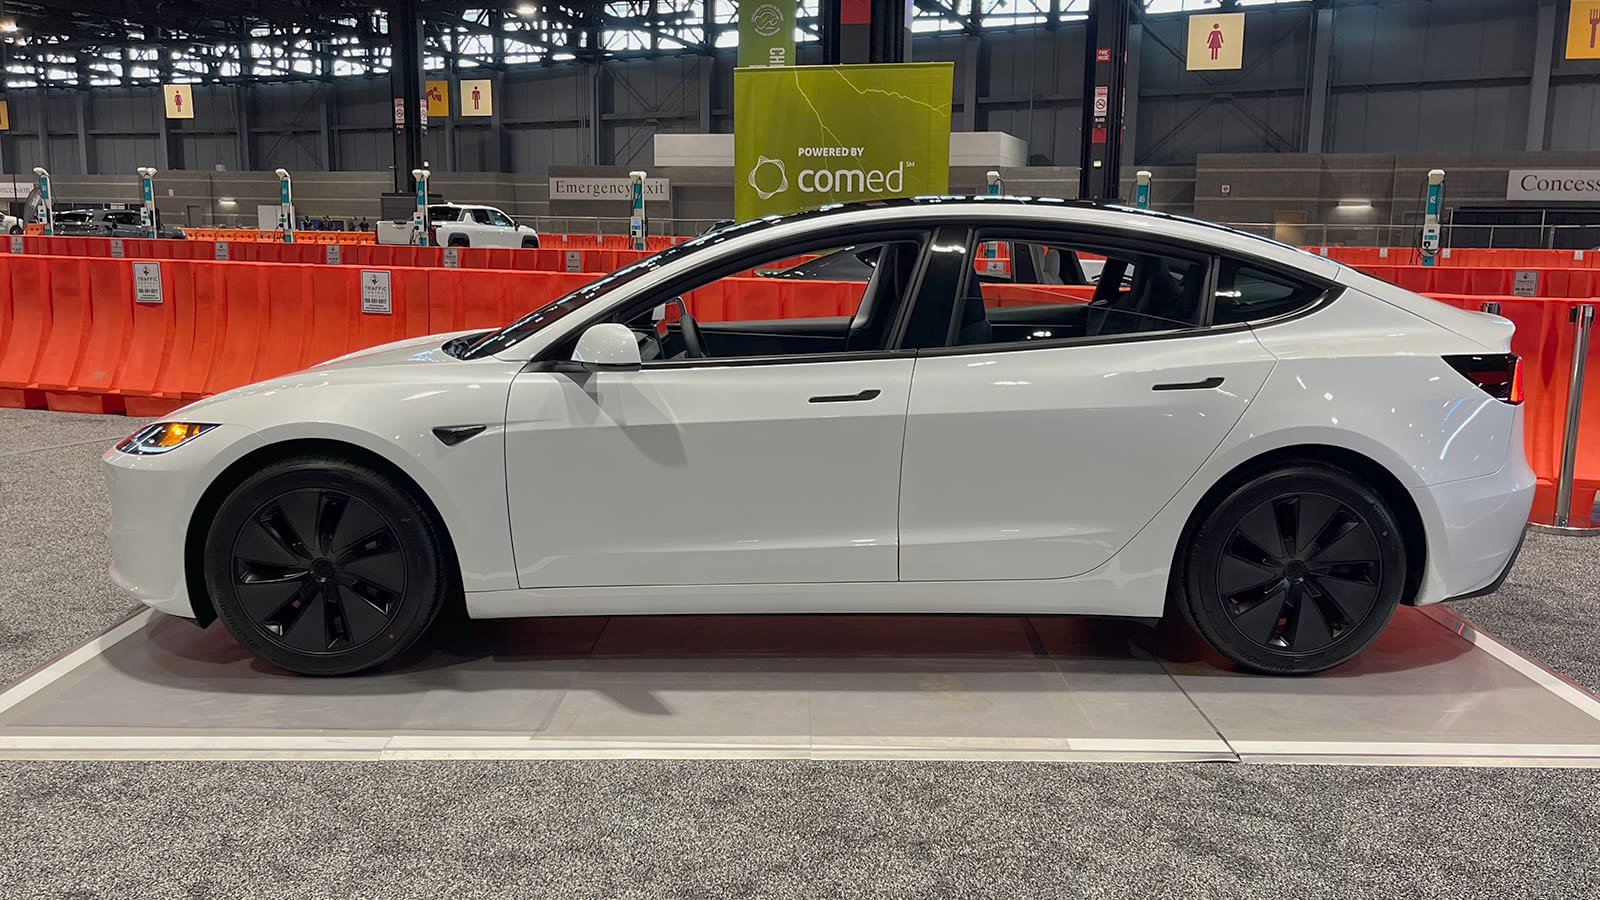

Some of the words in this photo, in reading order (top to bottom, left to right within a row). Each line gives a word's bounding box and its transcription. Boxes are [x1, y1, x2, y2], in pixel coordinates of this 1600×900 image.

[798, 147, 849, 157] POWERED
[851, 147, 864, 157] BY
[797, 160, 904, 193] comed
[555, 180, 632, 198] Emergency
[643, 180, 664, 194] xit
